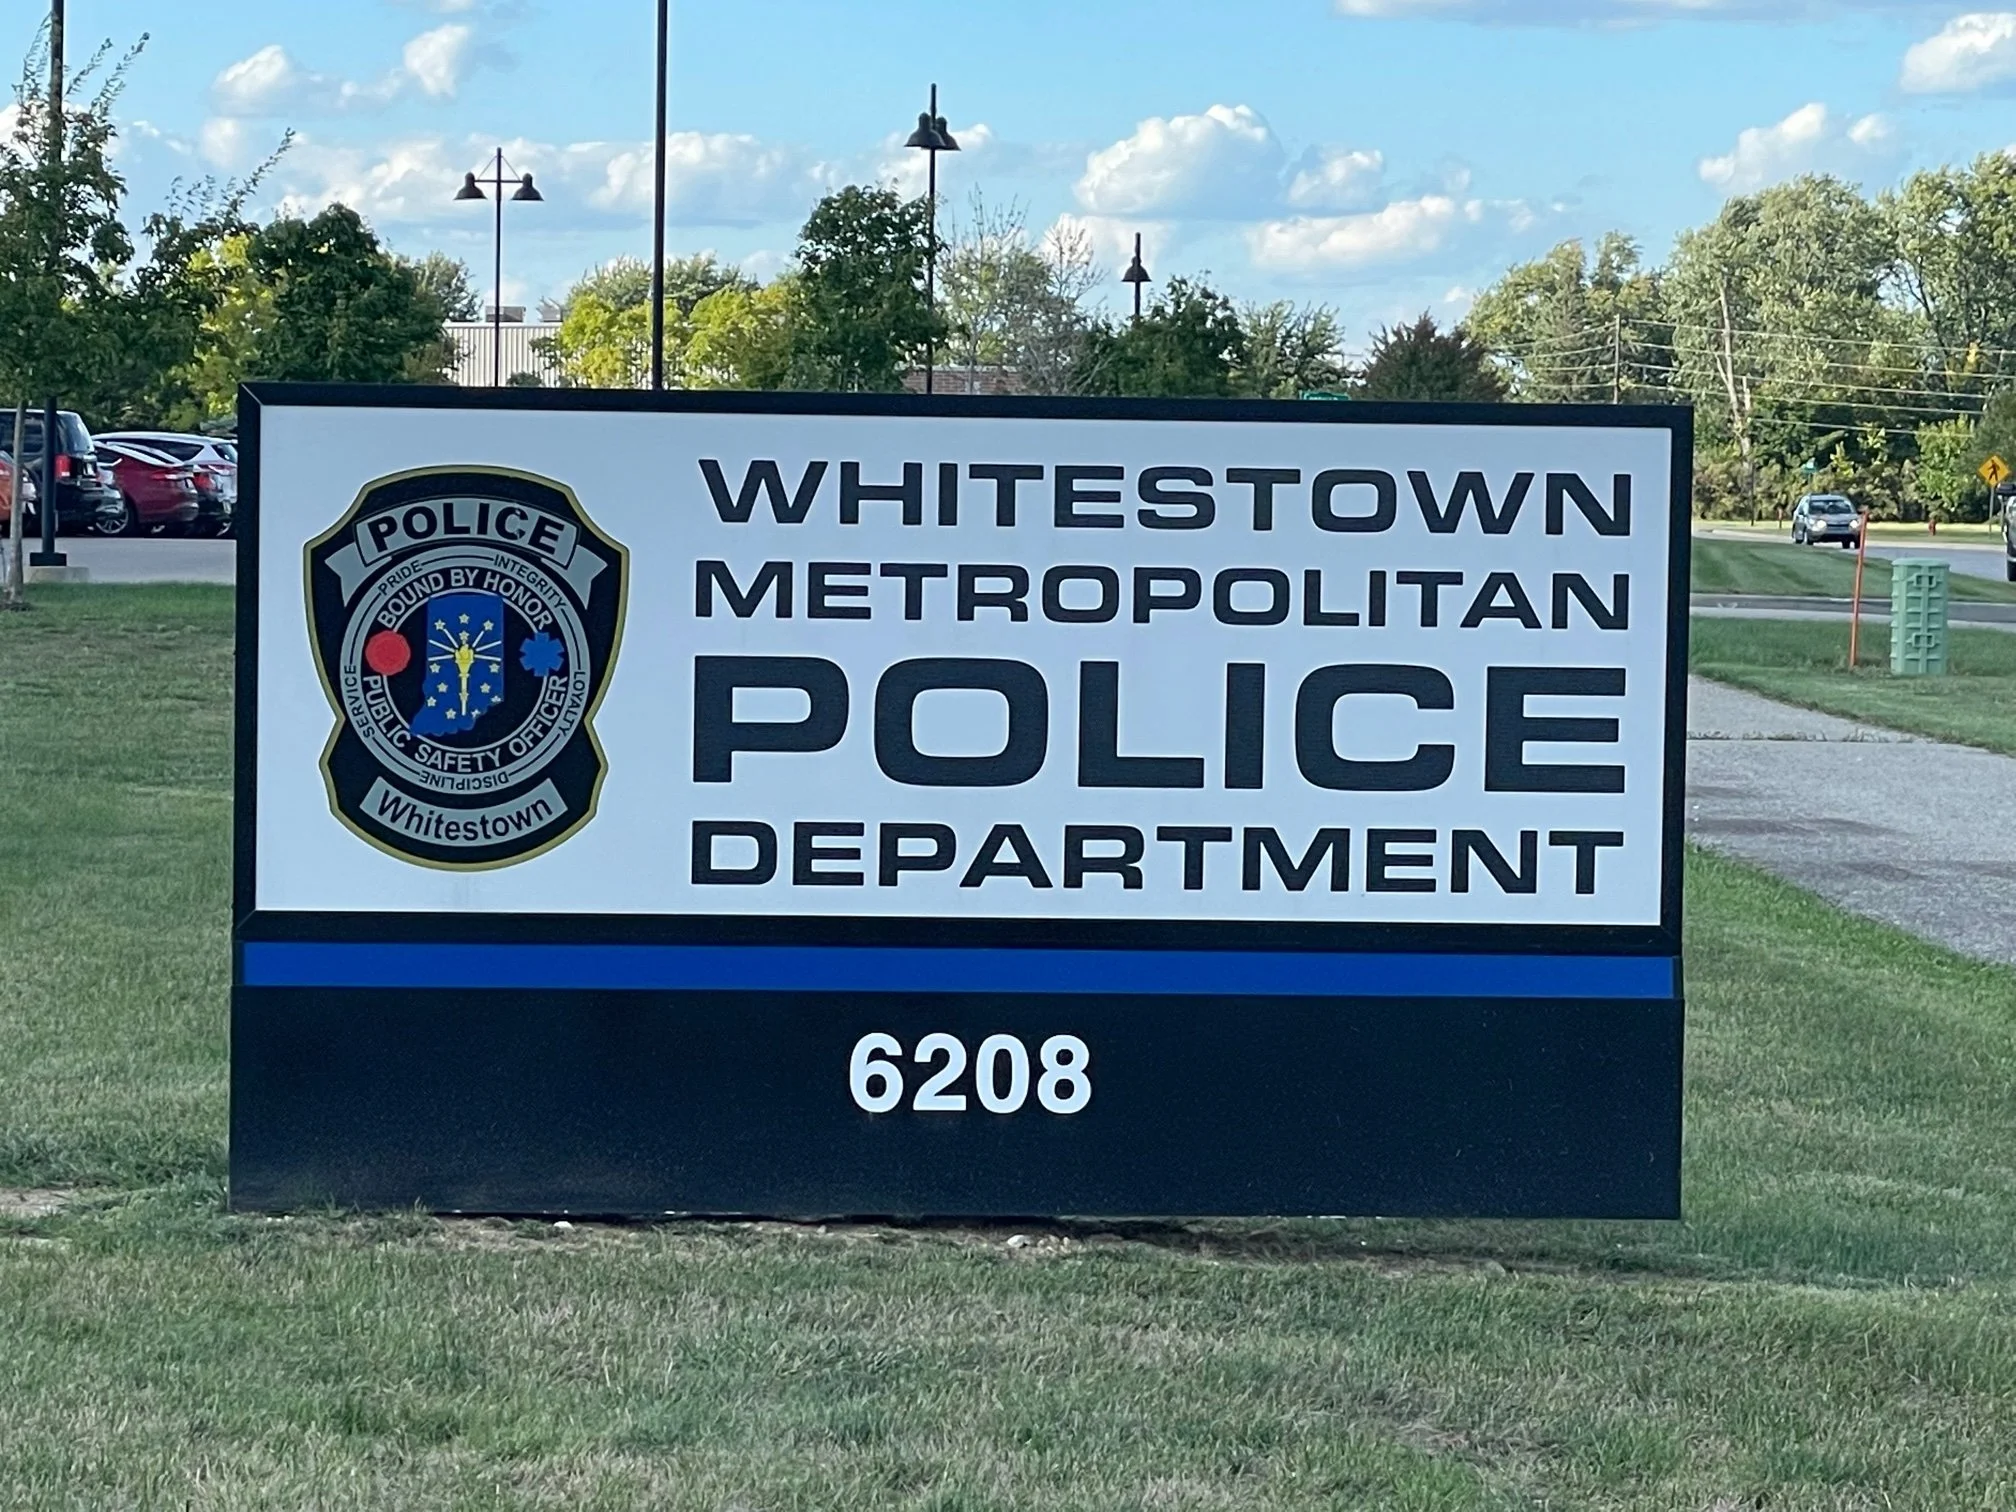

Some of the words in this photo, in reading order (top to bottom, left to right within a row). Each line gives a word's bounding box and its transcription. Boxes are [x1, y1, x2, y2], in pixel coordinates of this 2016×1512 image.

[367, 502, 565, 555] POLICE
[698, 459, 1631, 536] WHITESTOWN
[377, 560, 423, 595] PRIDE
[377, 573, 445, 629] BOUND
[450, 568, 477, 587] BY
[482, 573, 553, 630] HONOR
[493, 554, 568, 609] INTEGRITY
[696, 560, 1629, 630] METROPOLITAN
[344, 665, 375, 739] SERVICE
[363, 675, 411, 748] PUBLIC
[414, 743, 501, 773] SAFETY
[508, 675, 568, 756] OFFICER
[562, 671, 586, 737] LOYALTY
[693, 656, 1626, 793] POLICE
[377, 789, 553, 841] Whitestown
[419, 771, 509, 791] DISCIPLINE
[692, 821, 1623, 894] DEPARTMENT
[849, 1032, 1092, 1114] 6208
